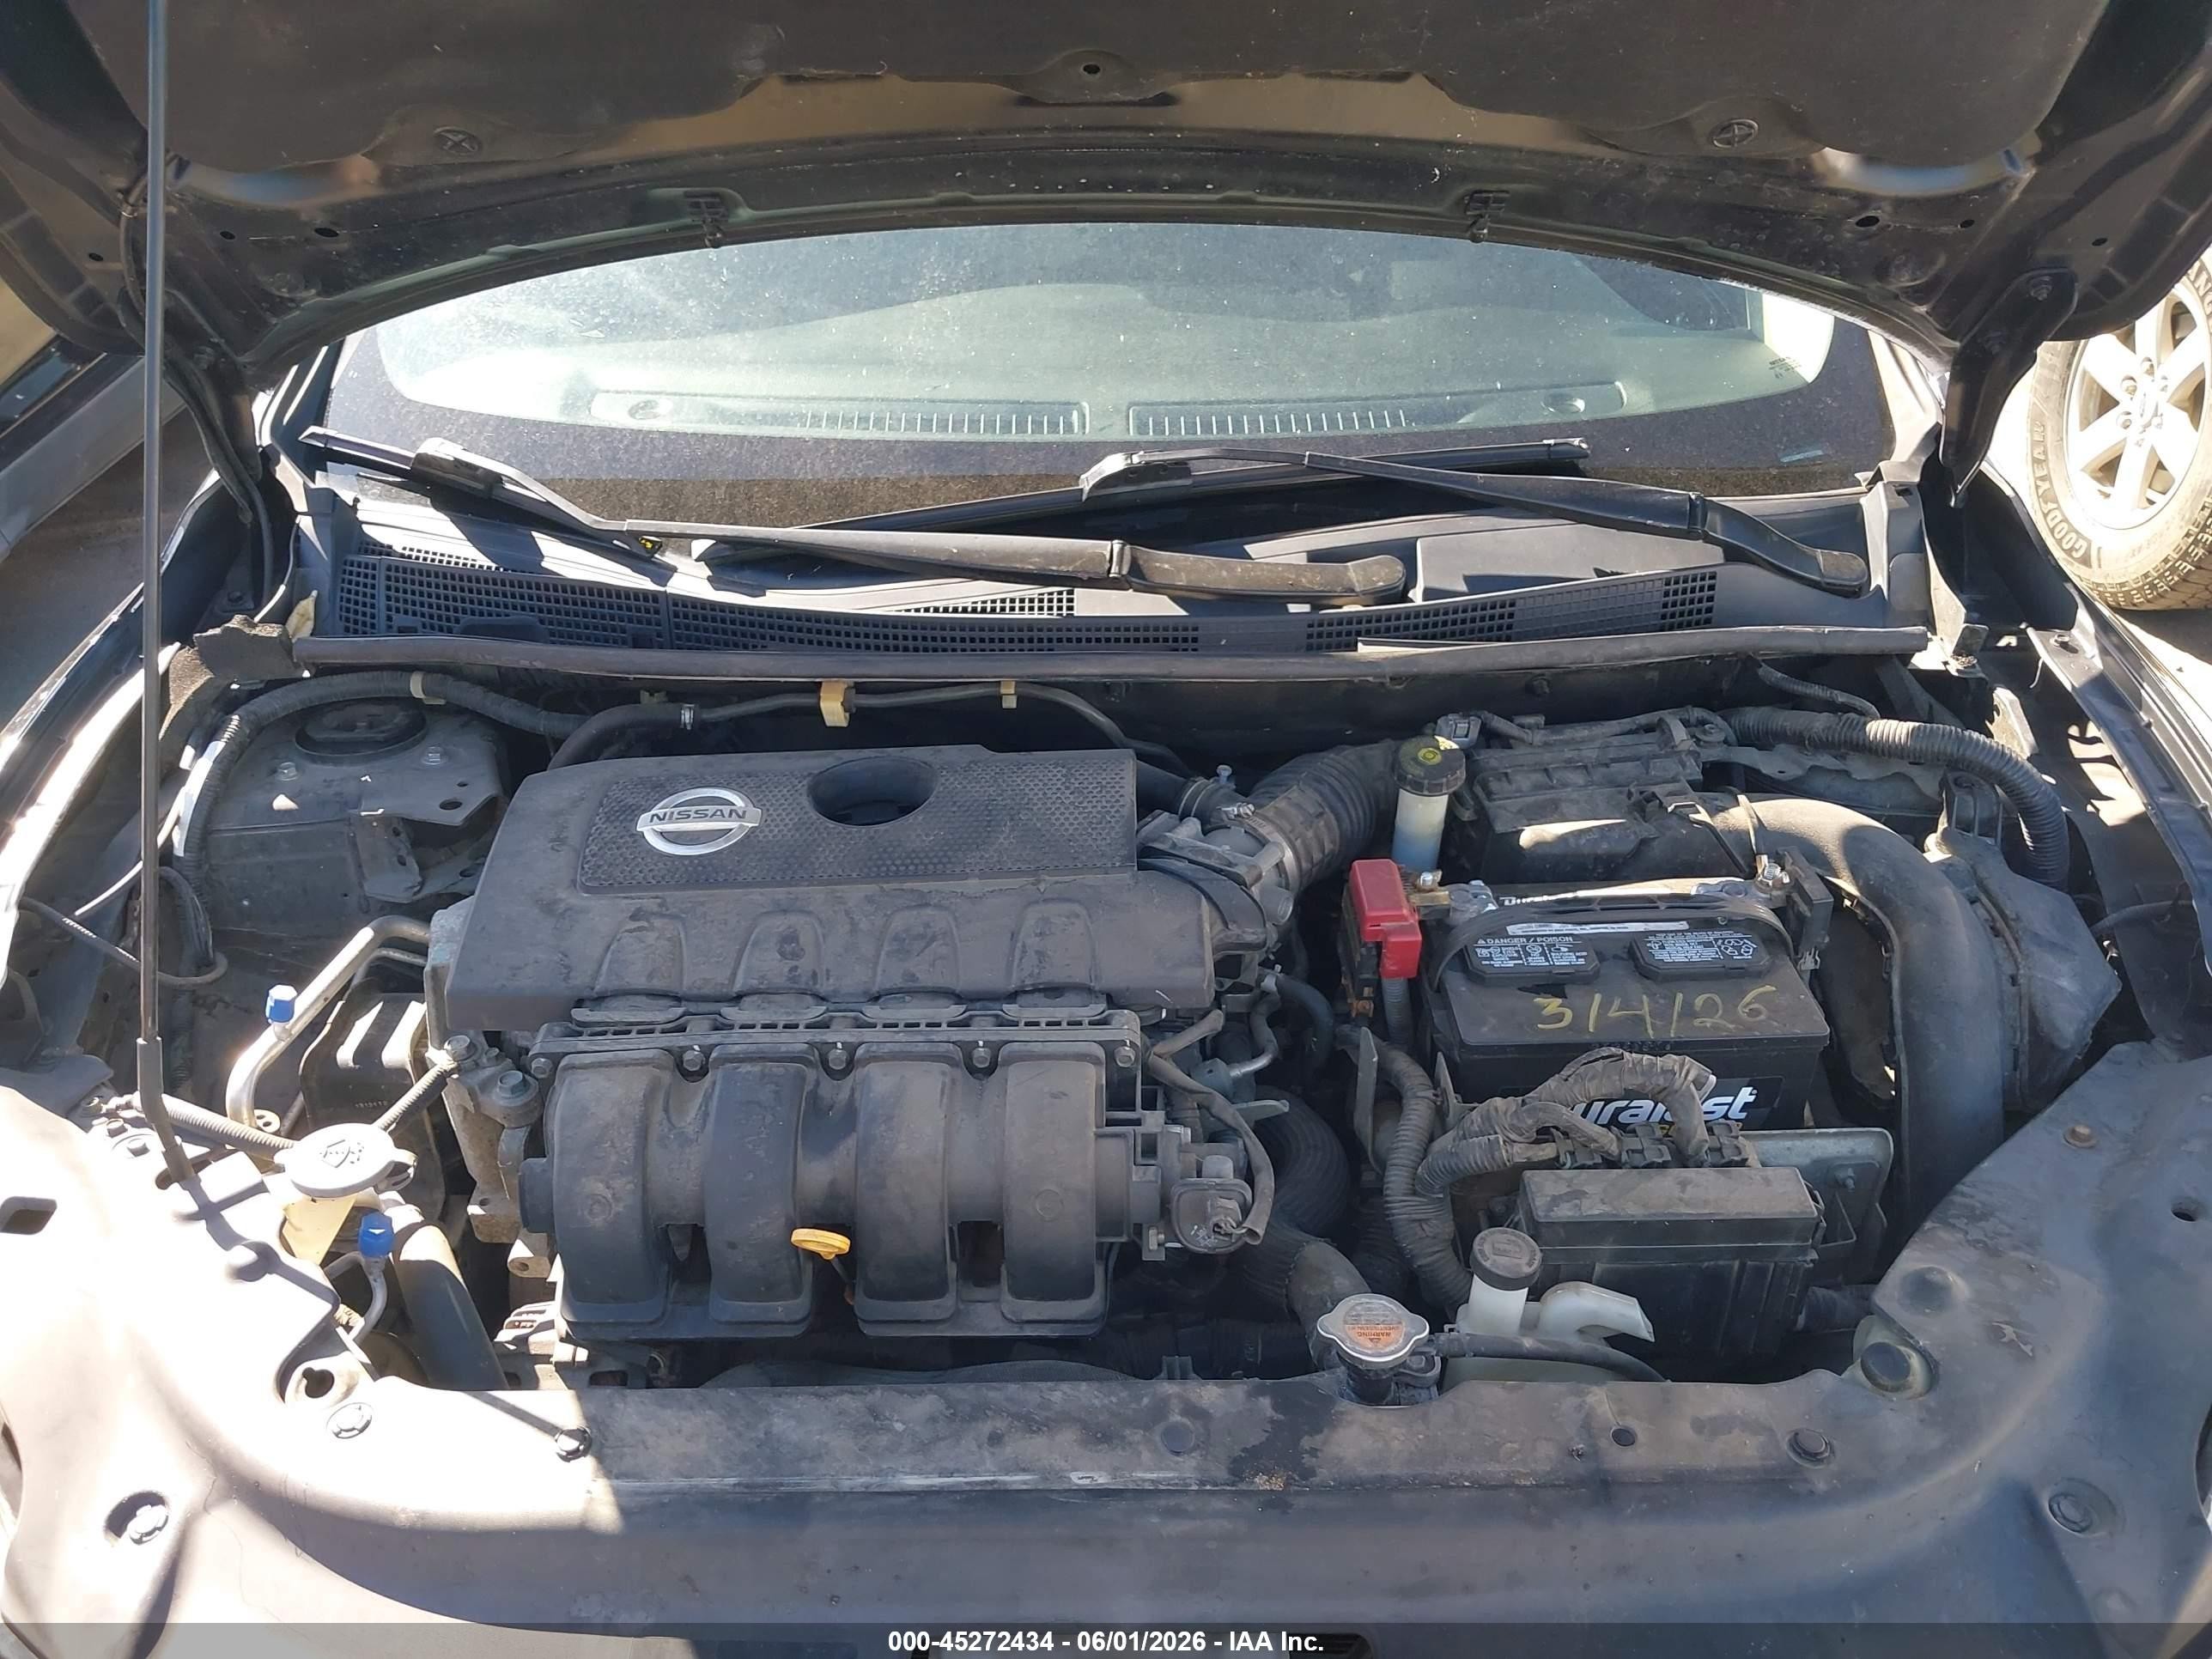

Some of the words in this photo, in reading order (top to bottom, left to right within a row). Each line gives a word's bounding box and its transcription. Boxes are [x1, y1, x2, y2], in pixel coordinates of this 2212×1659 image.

[2032, 420, 2088, 559] GOODYEAR
[648, 808, 747, 823] NISSAN
[1486, 936, 1527, 945] DANGER
[1571, 1085, 1758, 1126] uralst
